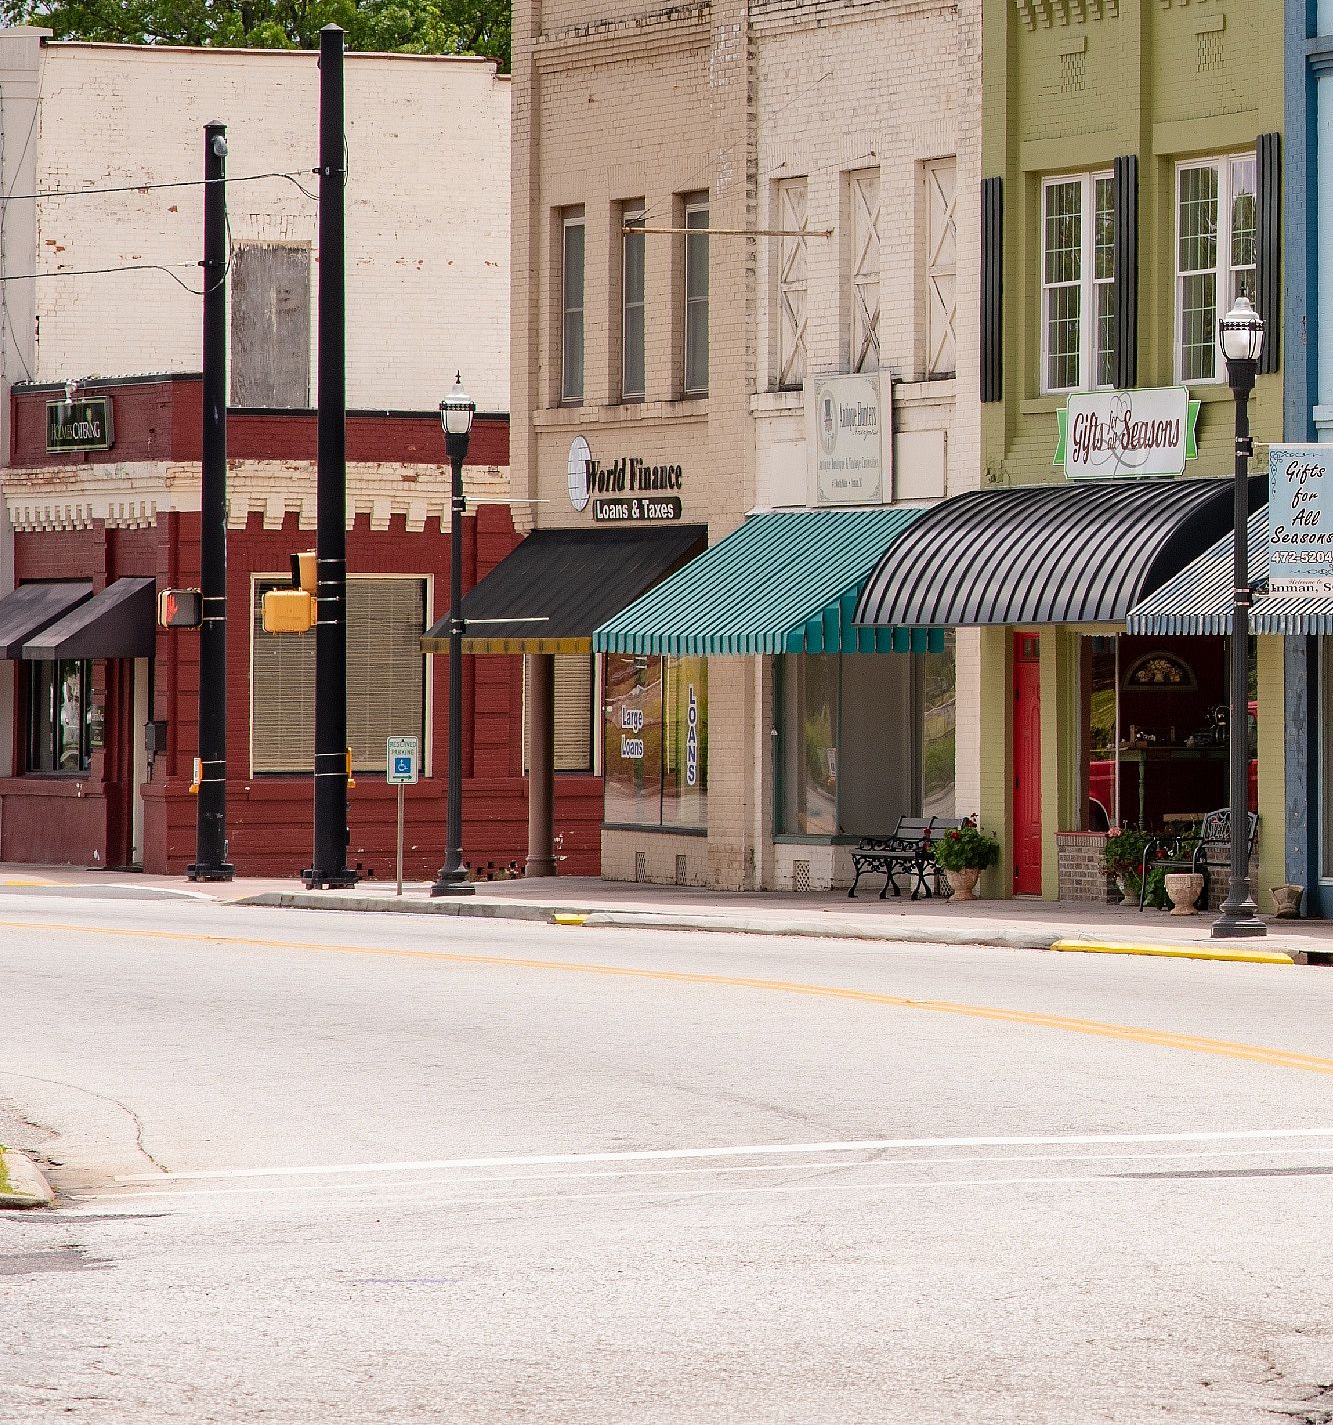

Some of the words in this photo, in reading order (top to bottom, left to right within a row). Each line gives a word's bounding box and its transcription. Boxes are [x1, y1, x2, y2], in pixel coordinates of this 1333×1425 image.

[1073, 412, 1104, 464] Gifts
[1120, 410, 1180, 451] Seasons
[585, 458, 627, 494] World
[629, 458, 682, 490] Finance
[1286, 460, 1326, 485] Gifts
[1291, 486, 1319, 509] for
[596, 501, 628, 519] Loans
[632, 500, 640, 519] &
[642, 500, 674, 519] Taxes
[1291, 508, 1321, 527] All
[1271, 551, 1333, 563] 472-5204
[1271, 583, 1319, 594] Inman,
[622, 707, 643, 731] Large
[622, 736, 643, 756] Loans
[688, 687, 697, 783] LOANS
